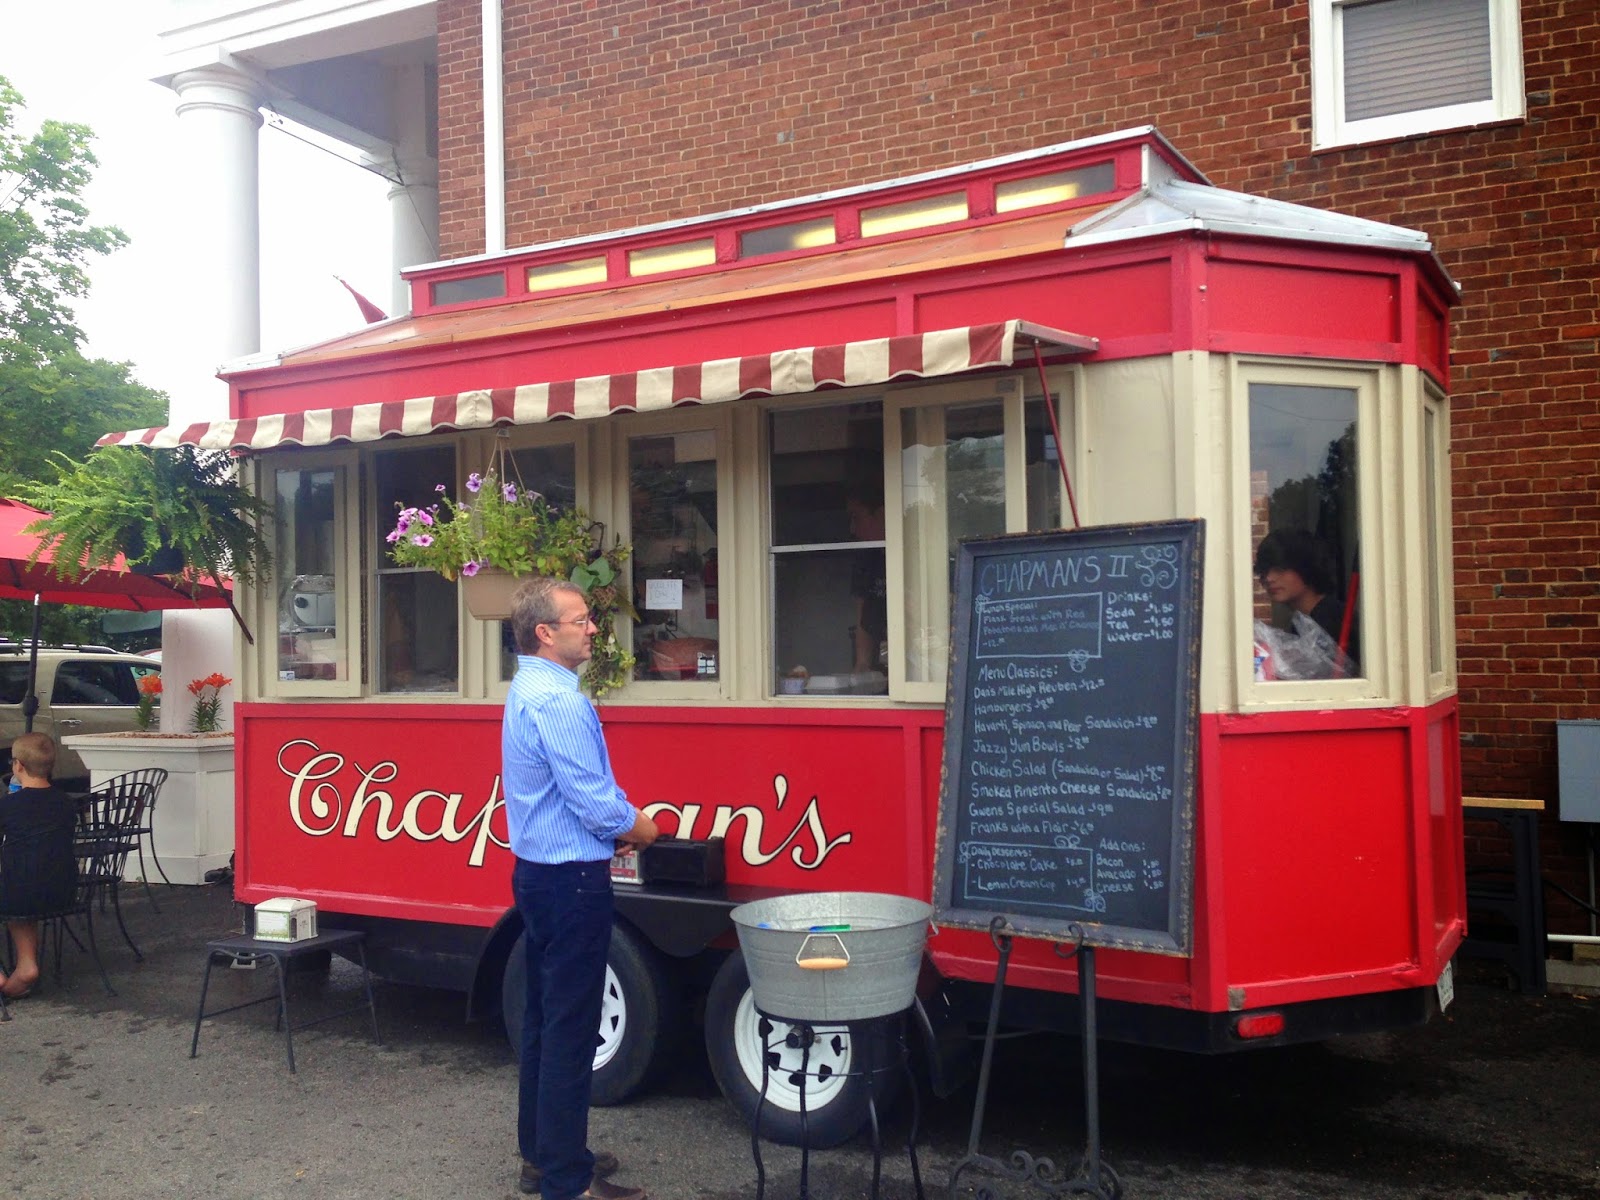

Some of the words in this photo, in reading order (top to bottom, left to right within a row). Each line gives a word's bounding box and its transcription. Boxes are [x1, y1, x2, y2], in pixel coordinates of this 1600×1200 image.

[980, 555, 1102, 596] CHAPMANS
[1106, 554, 1135, 577] II
[1107, 591, 1153, 604] Drinks:
[1065, 608, 1085, 619] Red
[1105, 607, 1136, 619] Soda
[977, 663, 1006, 681] Menu
[1006, 662, 1058, 680] Classics:
[1017, 683, 1036, 698] High
[1038, 681, 1078, 694] Reuben
[974, 702, 1033, 717] Hamburgers
[1084, 715, 1135, 730] Sandwich
[973, 739, 1008, 764] Jazzy
[1032, 735, 1065, 753] Bowls
[971, 760, 1012, 778] Chicken
[1012, 758, 1047, 777] Salad
[1100, 769, 1112, 779] or
[971, 781, 1012, 799] Smoked
[1013, 782, 1058, 799] Pimento
[1060, 781, 1101, 795] Cheese
[1106, 782, 1158, 801] Sandwich
[277, 737, 853, 869] Chapan's
[968, 802, 1004, 817] Gwens
[1006, 800, 1050, 821] Special
[1052, 800, 1086, 816] Salad
[970, 821, 1009, 836] Franks
[1011, 821, 1032, 833] with
[1033, 824, 1040, 833] a
[1099, 837, 1120, 851] Add
[1029, 857, 1058, 871] Cake
[1096, 853, 1124, 868] Bacon
[1096, 868, 1136, 880] Avacado
[1009, 876, 1040, 888] Cream
[1096, 882, 1134, 894] Cheese
